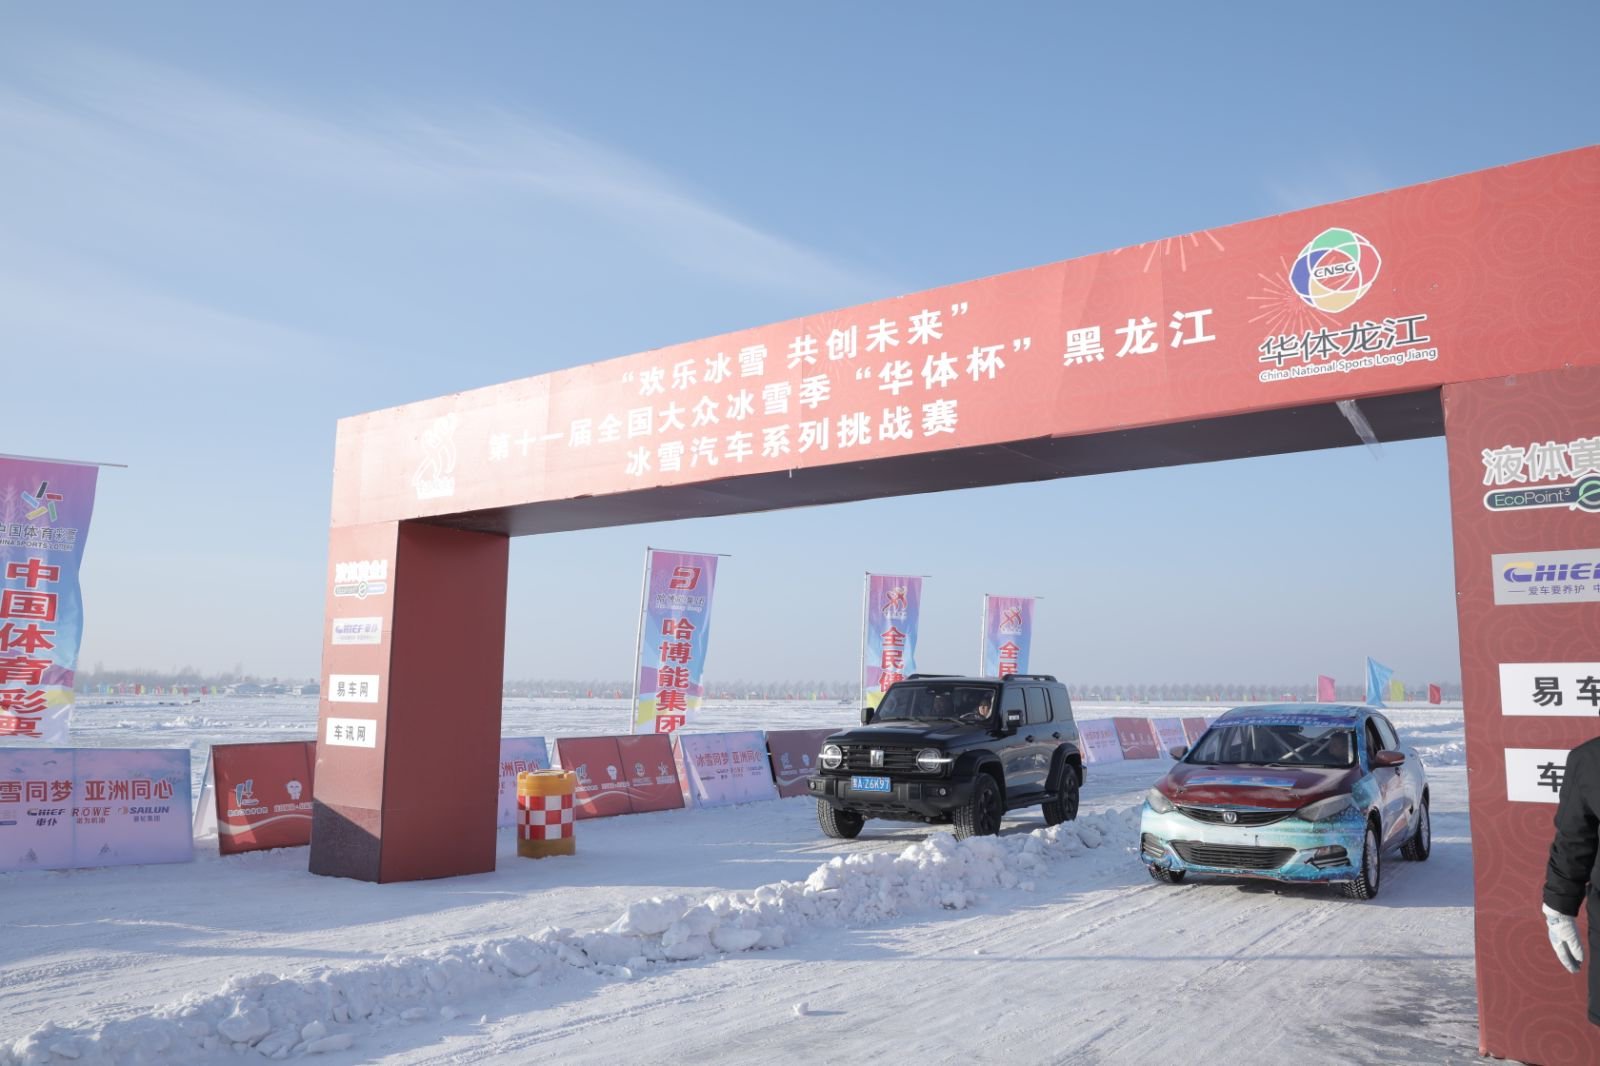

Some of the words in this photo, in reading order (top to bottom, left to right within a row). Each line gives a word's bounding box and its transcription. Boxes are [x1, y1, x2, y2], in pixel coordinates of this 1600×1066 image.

[1313, 262, 1357, 279] CNSG
[1063, 308, 1216, 366] 黑龙江
[1260, 314, 1430, 365] 华体龙江
[1260, 371, 1289, 381] China
[1292, 363, 1335, 376] National
[1338, 357, 1373, 371] Sports
[1376, 352, 1404, 366] Long
[1405, 348, 1437, 361] Jiang
[624, 399, 958, 477] 冰雪汽车系列挑战赛
[655, 617, 696, 734] 哈博能集团
[1532, 675, 1600, 707] 易车
[0, 780, 73, 803] 雪同梦
[85, 779, 173, 801] 亚洲同心
[27, 808, 66, 816] CHIEF
[71, 807, 112, 817] ROWE
[129, 806, 171, 815] SAILUN
